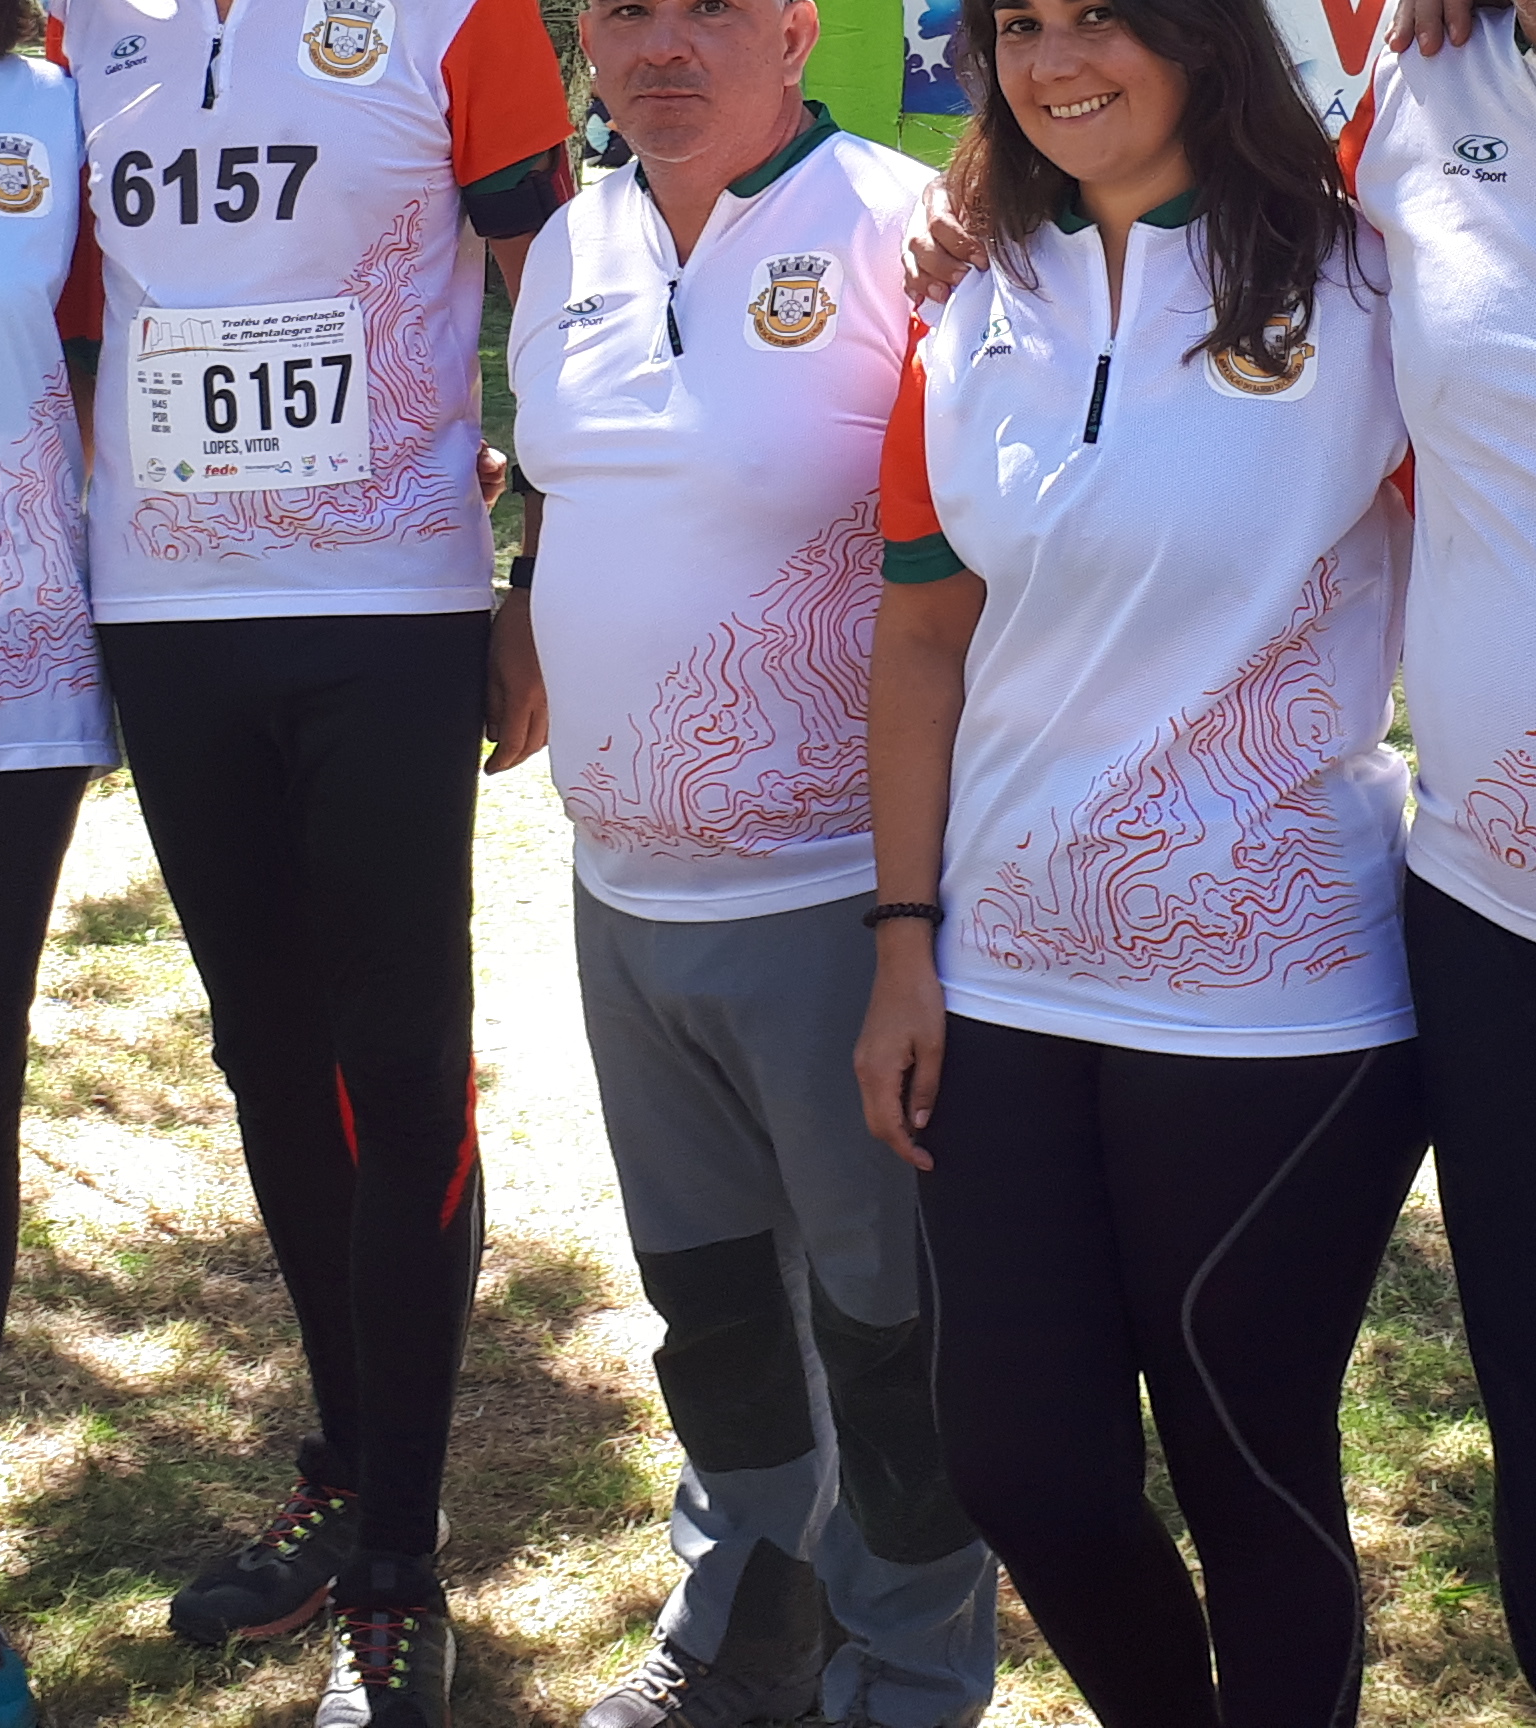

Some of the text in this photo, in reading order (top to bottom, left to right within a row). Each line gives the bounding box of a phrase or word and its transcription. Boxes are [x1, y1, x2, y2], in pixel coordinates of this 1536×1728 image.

[125, 54, 149, 72] Sport
[1442, 162, 1508, 184] Galo Sport
[111, 144, 319, 228] 6157
[221, 309, 346, 328] Troféu de Orientação
[221, 332, 238, 341] de
[240, 326, 312, 340] Montalegre
[314, 322, 345, 333] 2017
[203, 353, 353, 435] 6157
[202, 437, 280, 455] LOPES, VITOR
